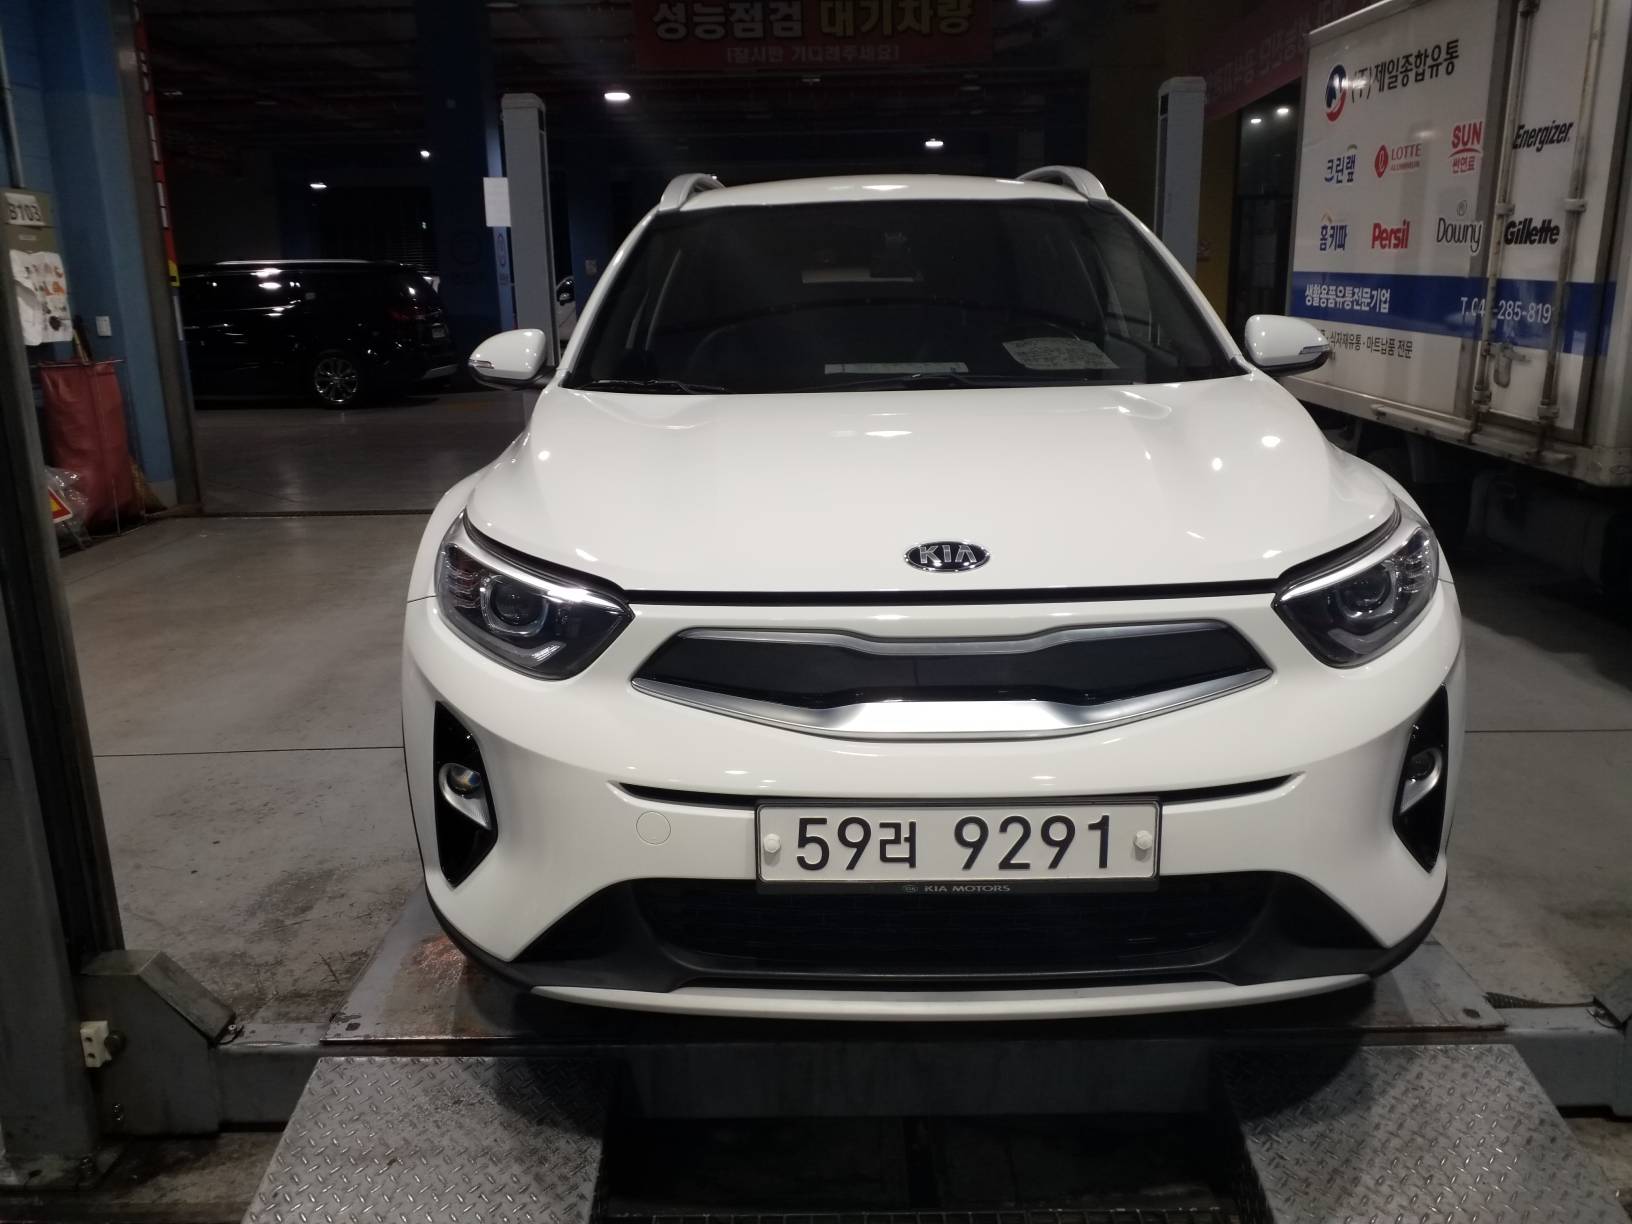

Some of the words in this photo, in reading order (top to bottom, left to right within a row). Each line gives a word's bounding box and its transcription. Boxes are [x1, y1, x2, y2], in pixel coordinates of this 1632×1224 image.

[652, 1, 803, 40] 성능점검
[819, 0, 976, 36] 대기차량
[1452, 121, 1482, 148] SUN
[1512, 120, 1574, 152] Energizer
[1391, 143, 1422, 160] LOTTE
[1319, 223, 1348, 251] 홈키파
[1371, 217, 1410, 249] Persil
[1436, 216, 1484, 253] Downy
[1504, 218, 1561, 246] Gillette
[920, 545, 977, 564] KIA
[796, 816, 917, 871] 59러
[953, 814, 1110, 871] 9291
